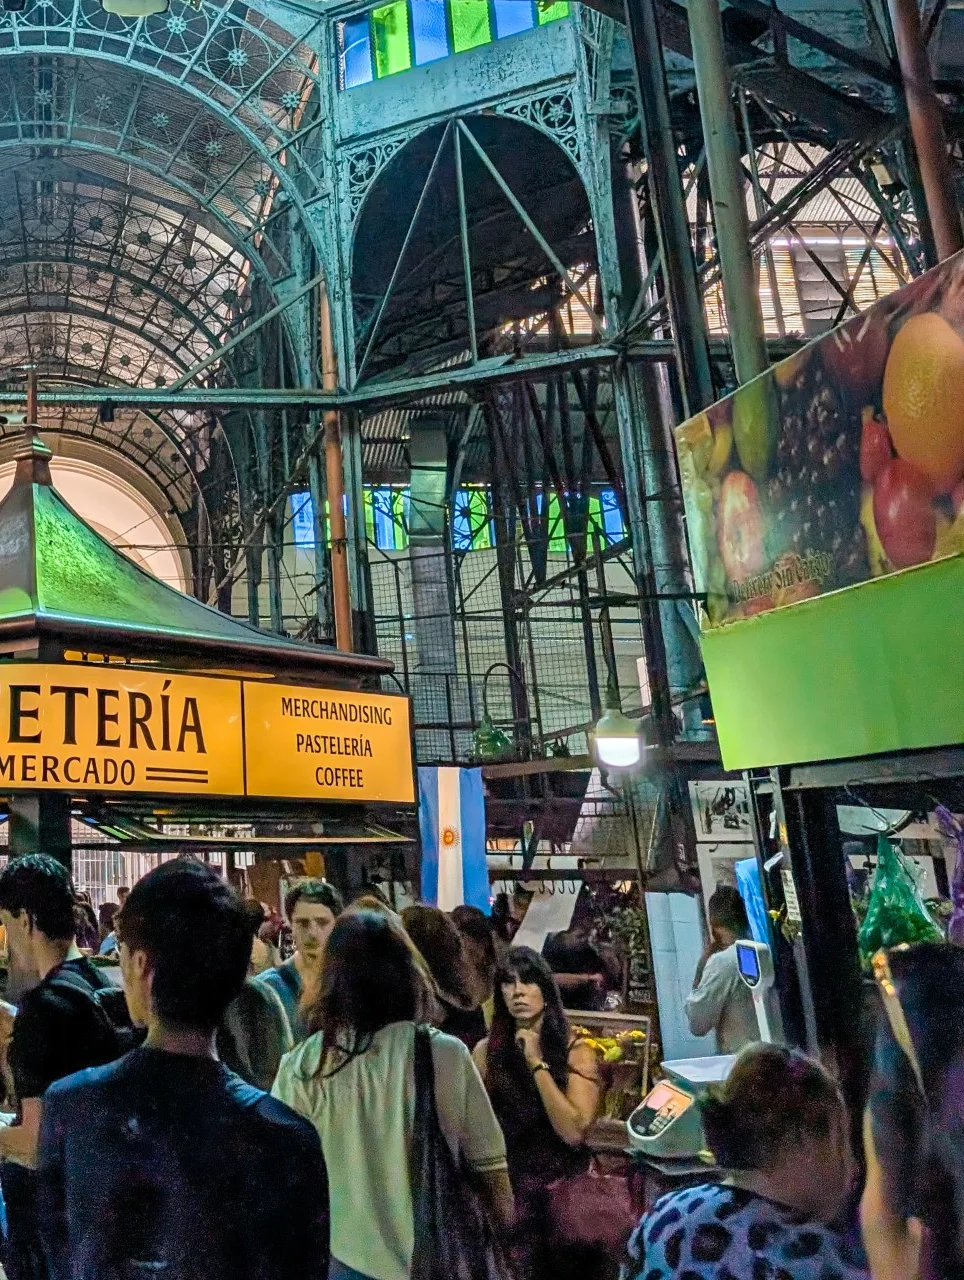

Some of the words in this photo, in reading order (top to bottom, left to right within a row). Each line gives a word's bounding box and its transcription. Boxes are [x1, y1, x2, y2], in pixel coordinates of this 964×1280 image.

[281, 696, 392, 726] MERCHANDISING
[296, 733, 373, 758] PASTELERÍA
[315, 766, 364, 788] COFFEE
